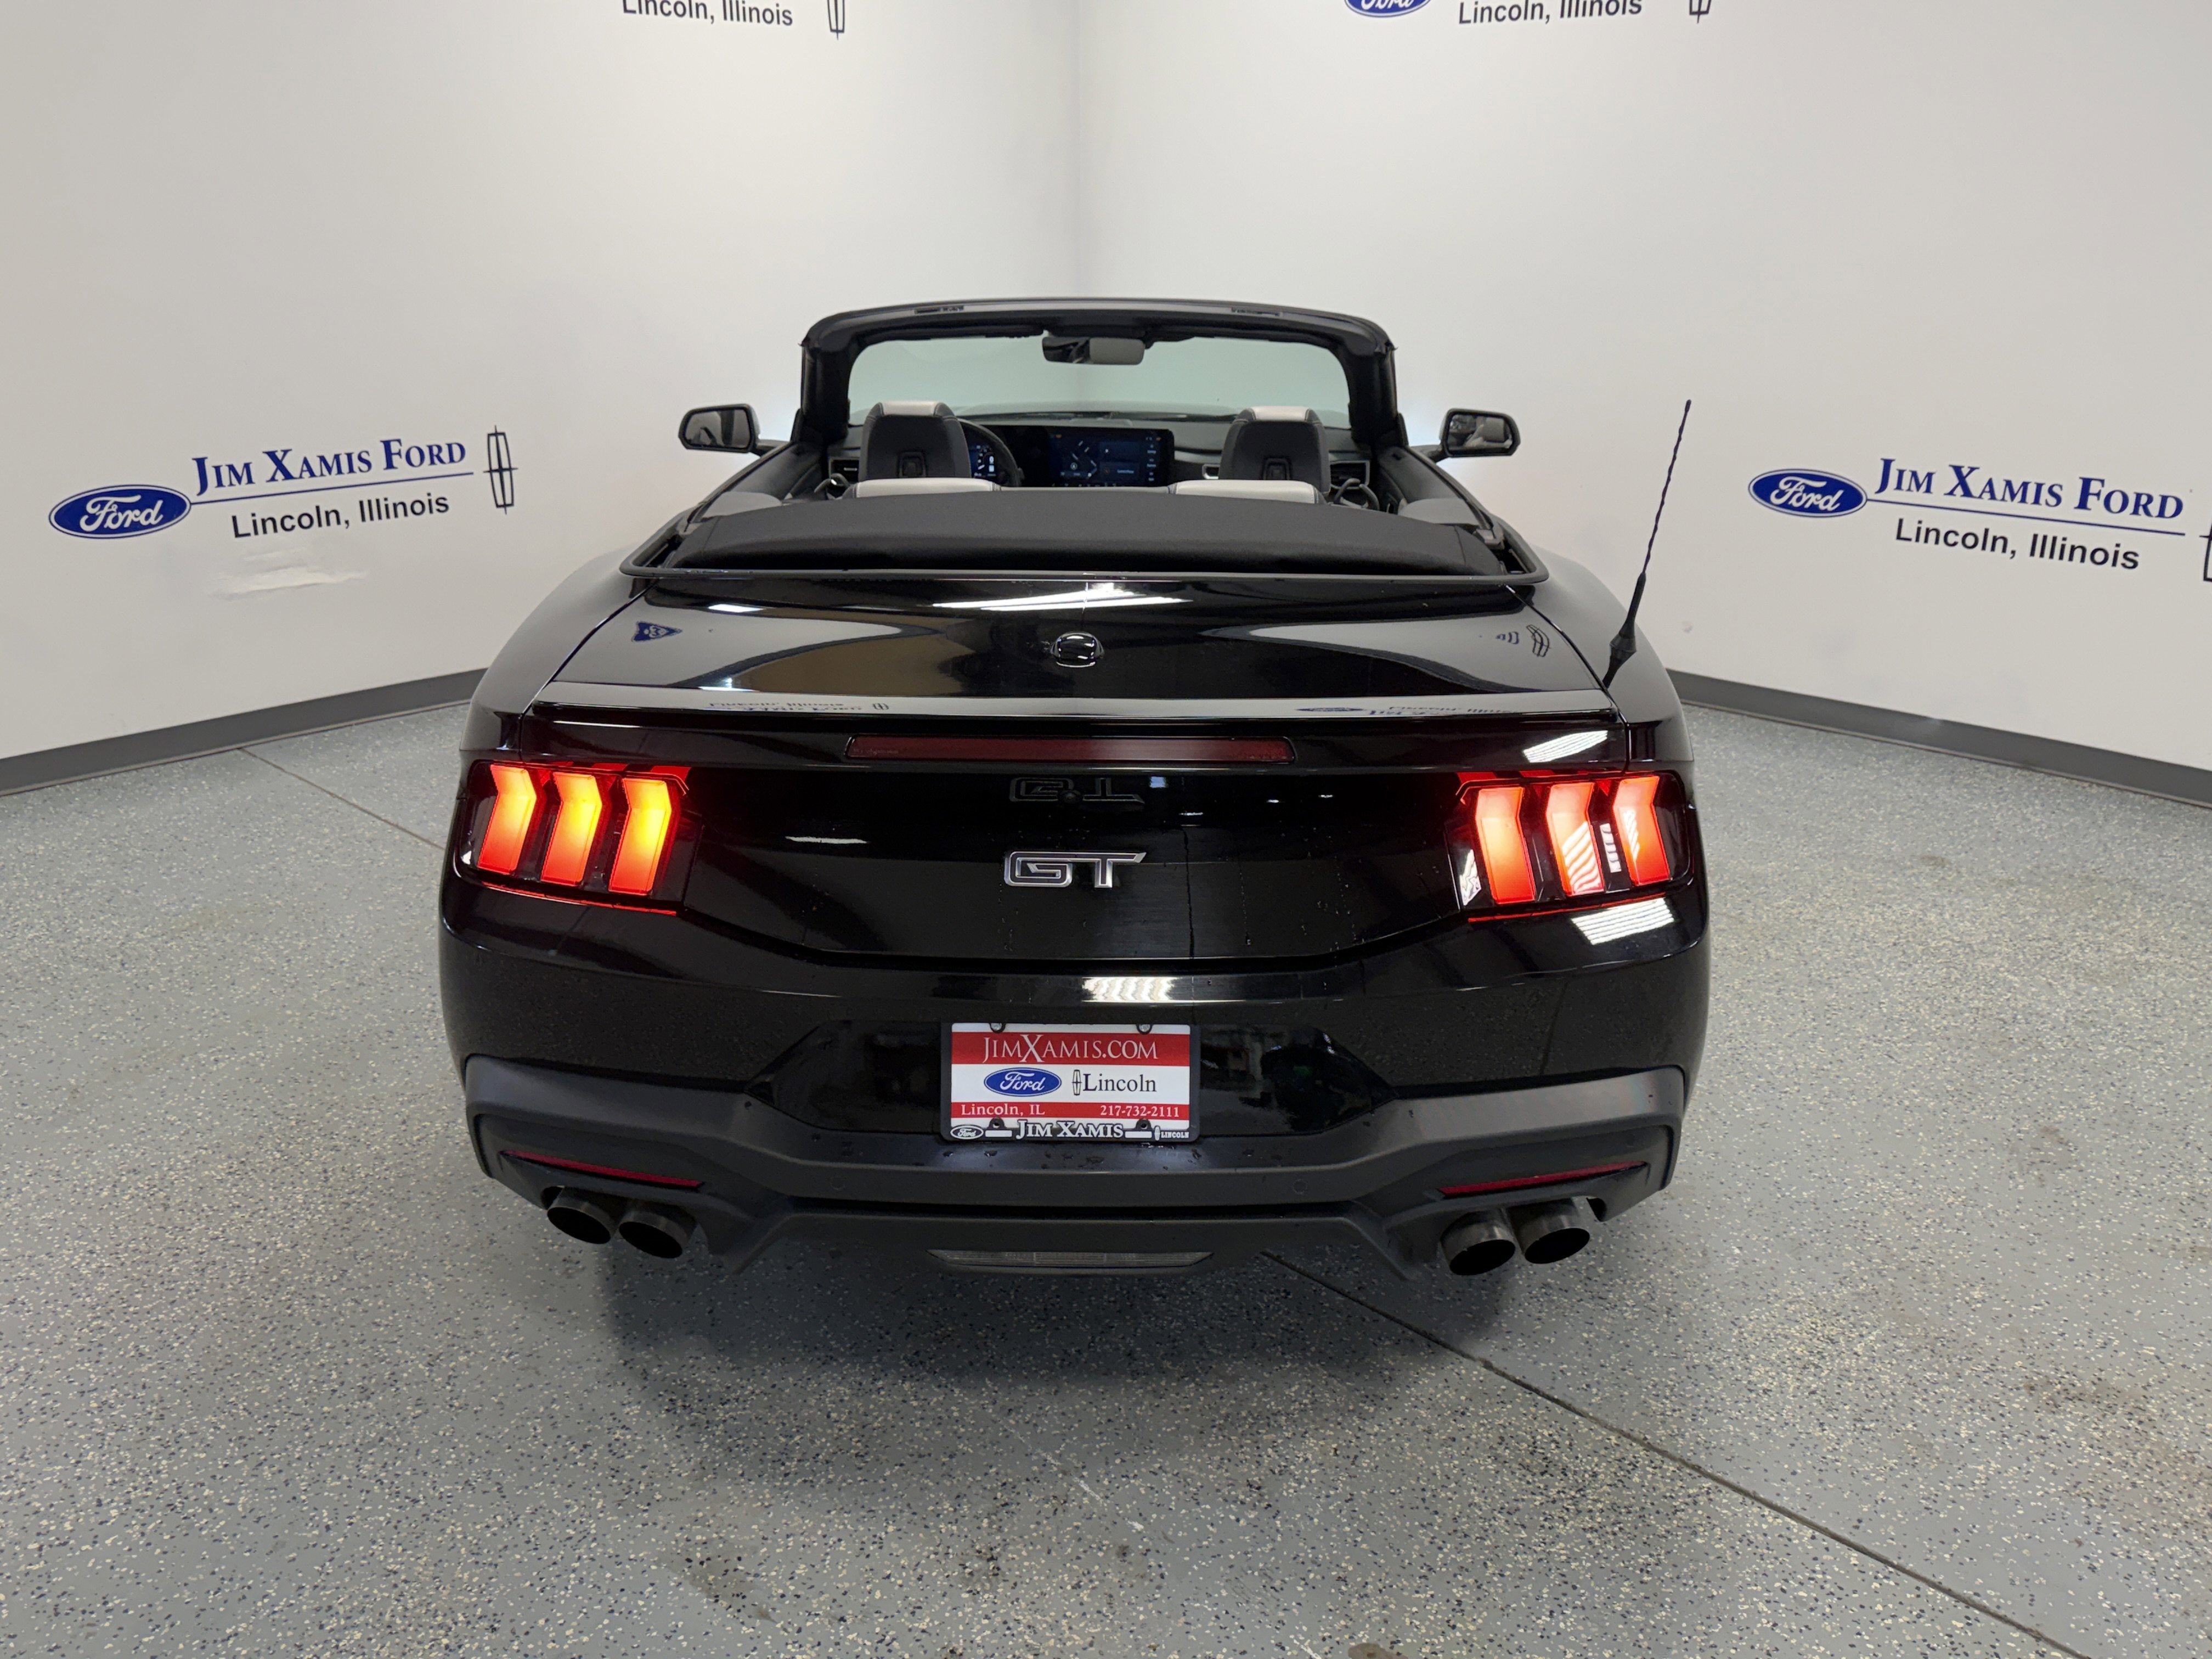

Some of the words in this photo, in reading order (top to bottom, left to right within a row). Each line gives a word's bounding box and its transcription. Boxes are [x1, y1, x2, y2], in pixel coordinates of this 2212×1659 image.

[723, 0, 793, 26] Illinois
[1459, 0, 1550, 24] Lincoln,
[192, 456, 256, 496] JIM
[262, 449, 373, 483] XAMIS
[380, 439, 466, 471] FORD
[1769, 475, 1843, 514] Ford
[1875, 458, 1936, 494] JIM
[1944, 464, 2063, 507] XAMIS
[2074, 476, 2184, 520] FORD
[78, 494, 165, 532] Ford
[232, 504, 351, 539] Lincoln,
[359, 493, 450, 523] Illinois
[1896, 518, 2017, 560] Lincoln,
[2029, 533, 2140, 570] Illinois
[1003, 851, 1147, 888] GT
[982, 1034, 1158, 1063] JIMXAMIS.COM
[1000, 1071, 1045, 1091] Ford
[1082, 1073, 1157, 1092] Lincoln
[961, 1103, 1023, 1116] Lincoln,
[1030, 1104, 1045, 1115] IL
[1100, 1105, 1180, 1118] 217-732-2111
[957, 1127, 977, 1137] Ford
[1015, 1120, 1053, 1139] JIM
[1057, 1121, 1124, 1138] XAMIS
[1160, 1131, 1189, 1139] LINCOLN
